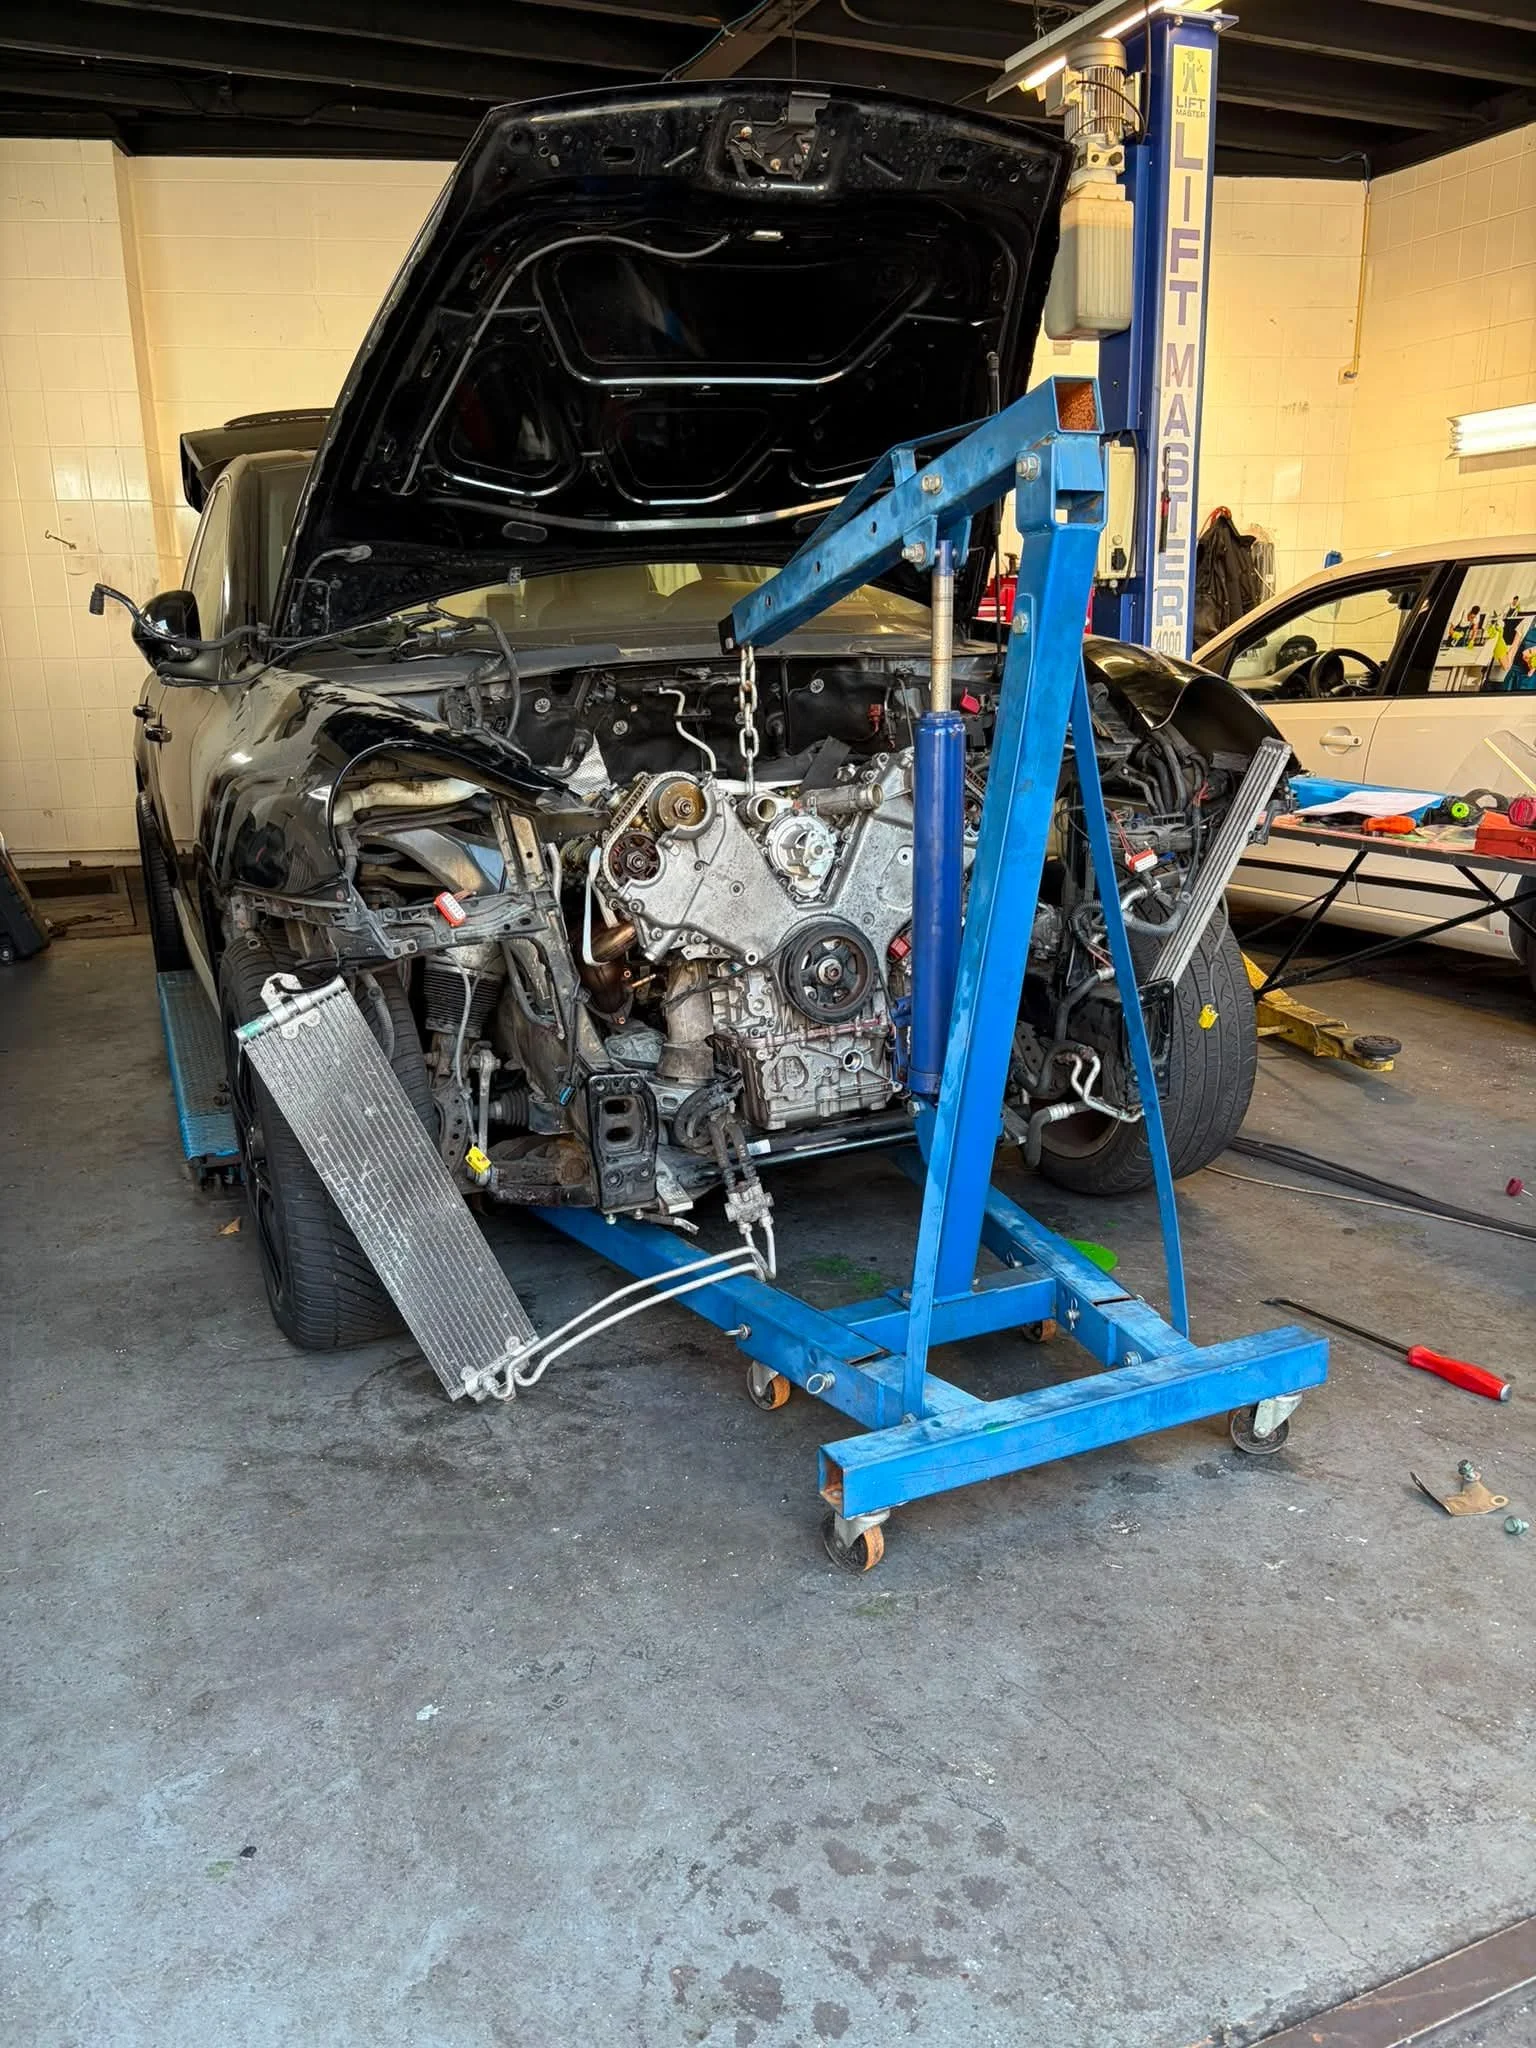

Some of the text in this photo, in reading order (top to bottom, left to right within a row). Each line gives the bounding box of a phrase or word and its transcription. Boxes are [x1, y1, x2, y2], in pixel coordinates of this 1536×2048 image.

[1175, 109, 1206, 118] MASTER
[1176, 95, 1206, 110] LIFT
[1169, 122, 1204, 326] LIFT
[1155, 342, 1195, 626] MASTER
[1155, 630, 1182, 656] 4000
